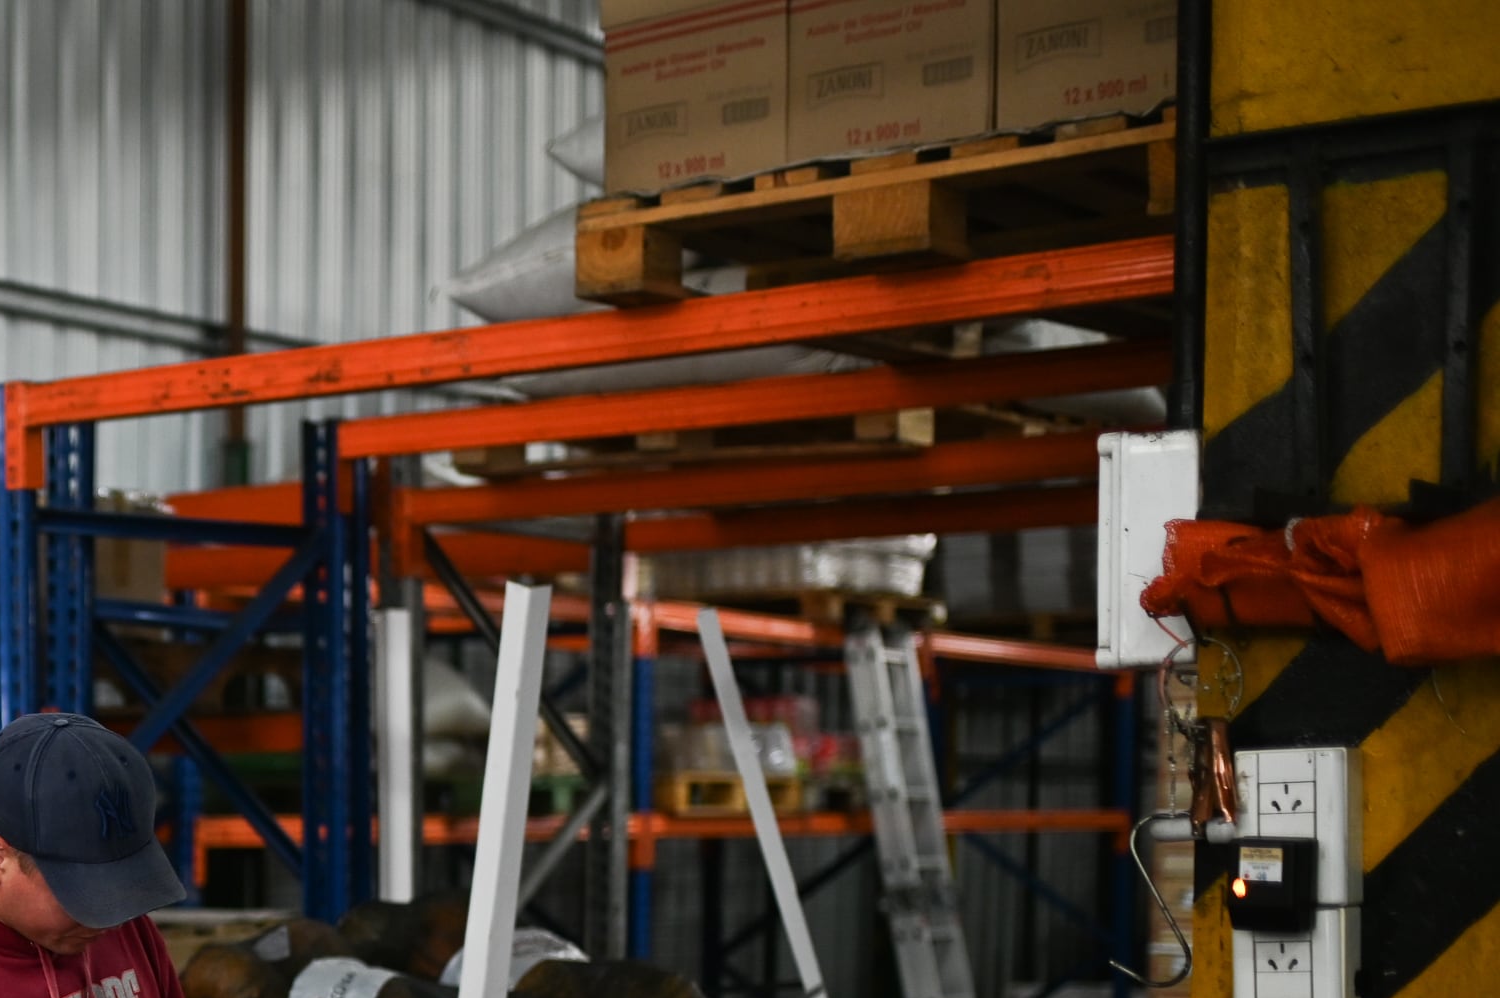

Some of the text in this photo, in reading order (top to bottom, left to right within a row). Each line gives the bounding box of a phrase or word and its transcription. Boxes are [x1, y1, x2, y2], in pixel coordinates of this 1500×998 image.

[1025, 26, 1089, 60] ZANONI
[816, 66, 874, 100] ZANONI
[1063, 86, 1081, 105] 12
[1084, 88, 1094, 102] x
[1127, 73, 1148, 95] ml
[628, 109, 678, 138] ZANONI
[846, 127, 861, 146] 12
[865, 131, 872, 143] x
[903, 116, 922, 135] ml
[658, 161, 671, 179] 12
[674, 164, 682, 177] x
[708, 152, 726, 169] ml
